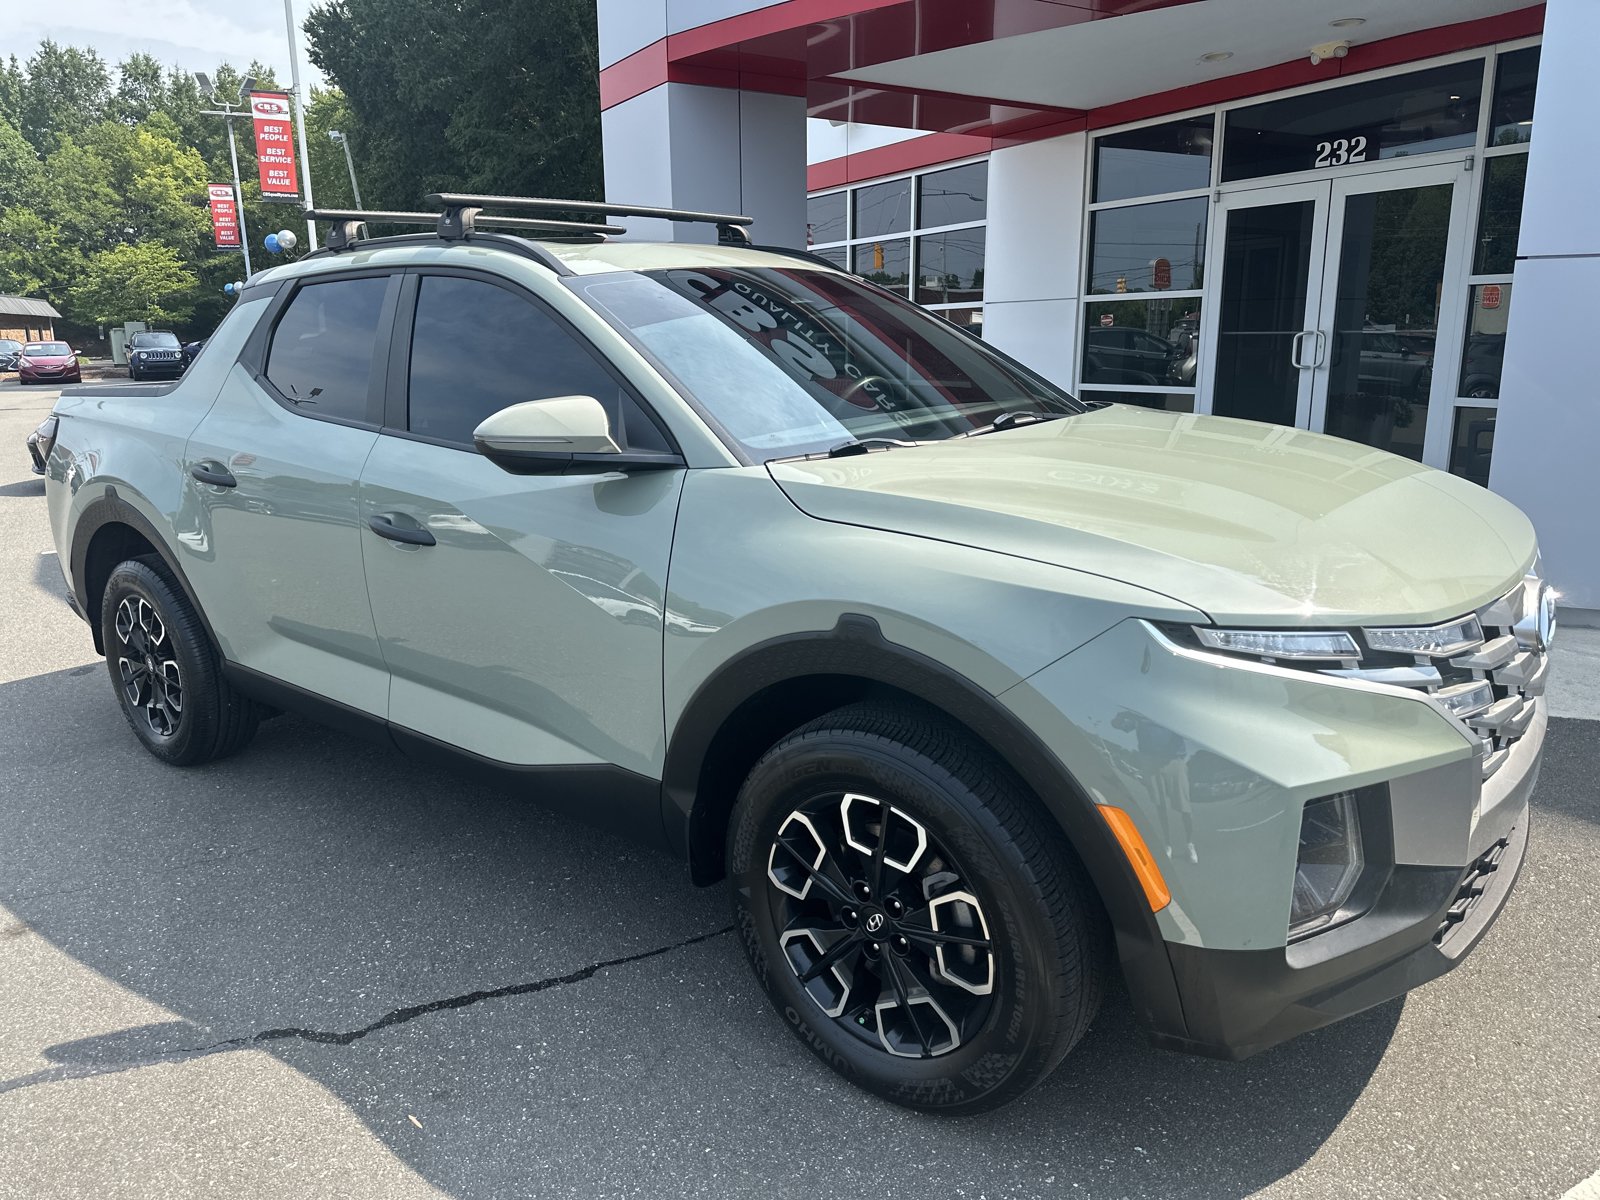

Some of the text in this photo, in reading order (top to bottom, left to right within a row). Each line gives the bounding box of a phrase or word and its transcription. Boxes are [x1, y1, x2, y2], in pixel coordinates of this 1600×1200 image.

[257, 103, 278, 111] CBS
[264, 125, 283, 133] BEST
[260, 133, 289, 142] PEOPLE
[266, 148, 286, 156] BEST
[1314, 136, 1367, 168] 232
[260, 156, 292, 164] SERVICE
[268, 170, 288, 178] BEST
[267, 177, 291, 186] VALUE
